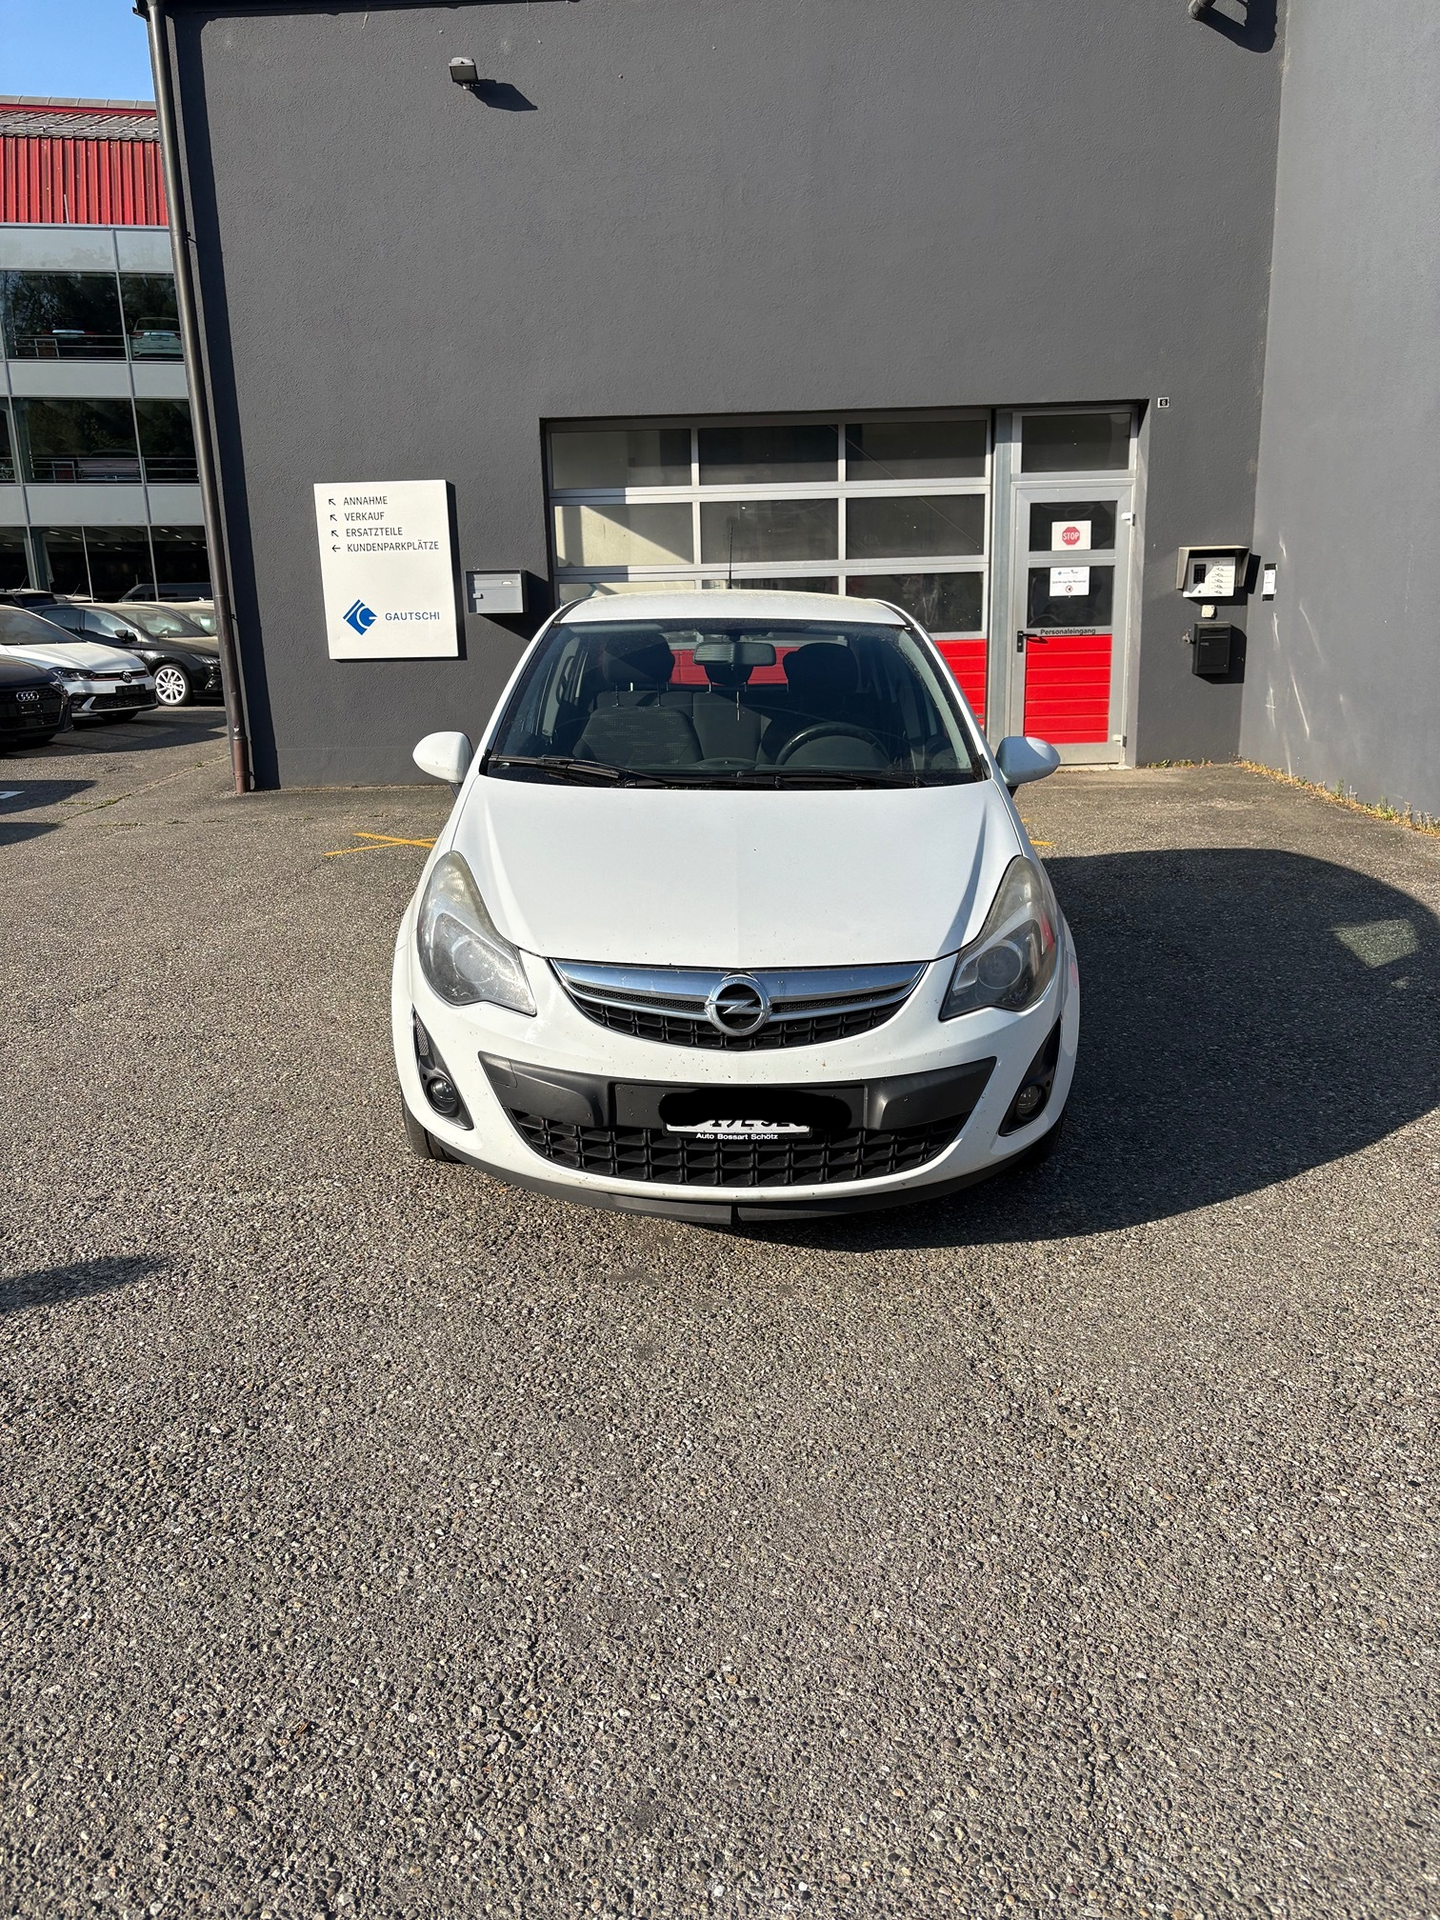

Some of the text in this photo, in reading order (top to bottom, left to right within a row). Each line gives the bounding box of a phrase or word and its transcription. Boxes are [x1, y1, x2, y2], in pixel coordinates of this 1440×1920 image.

[343, 496, 388, 506] ANNAHME
[344, 511, 385, 521] VERKAUF
[346, 527, 403, 537] ERSATZTEILE
[1062, 532, 1079, 540] STOP
[347, 540, 439, 552] KUNDENPARKPLÄTZE
[385, 612, 440, 620] GAUTSCHI
[1040, 628, 1096, 636] Personaleingang
